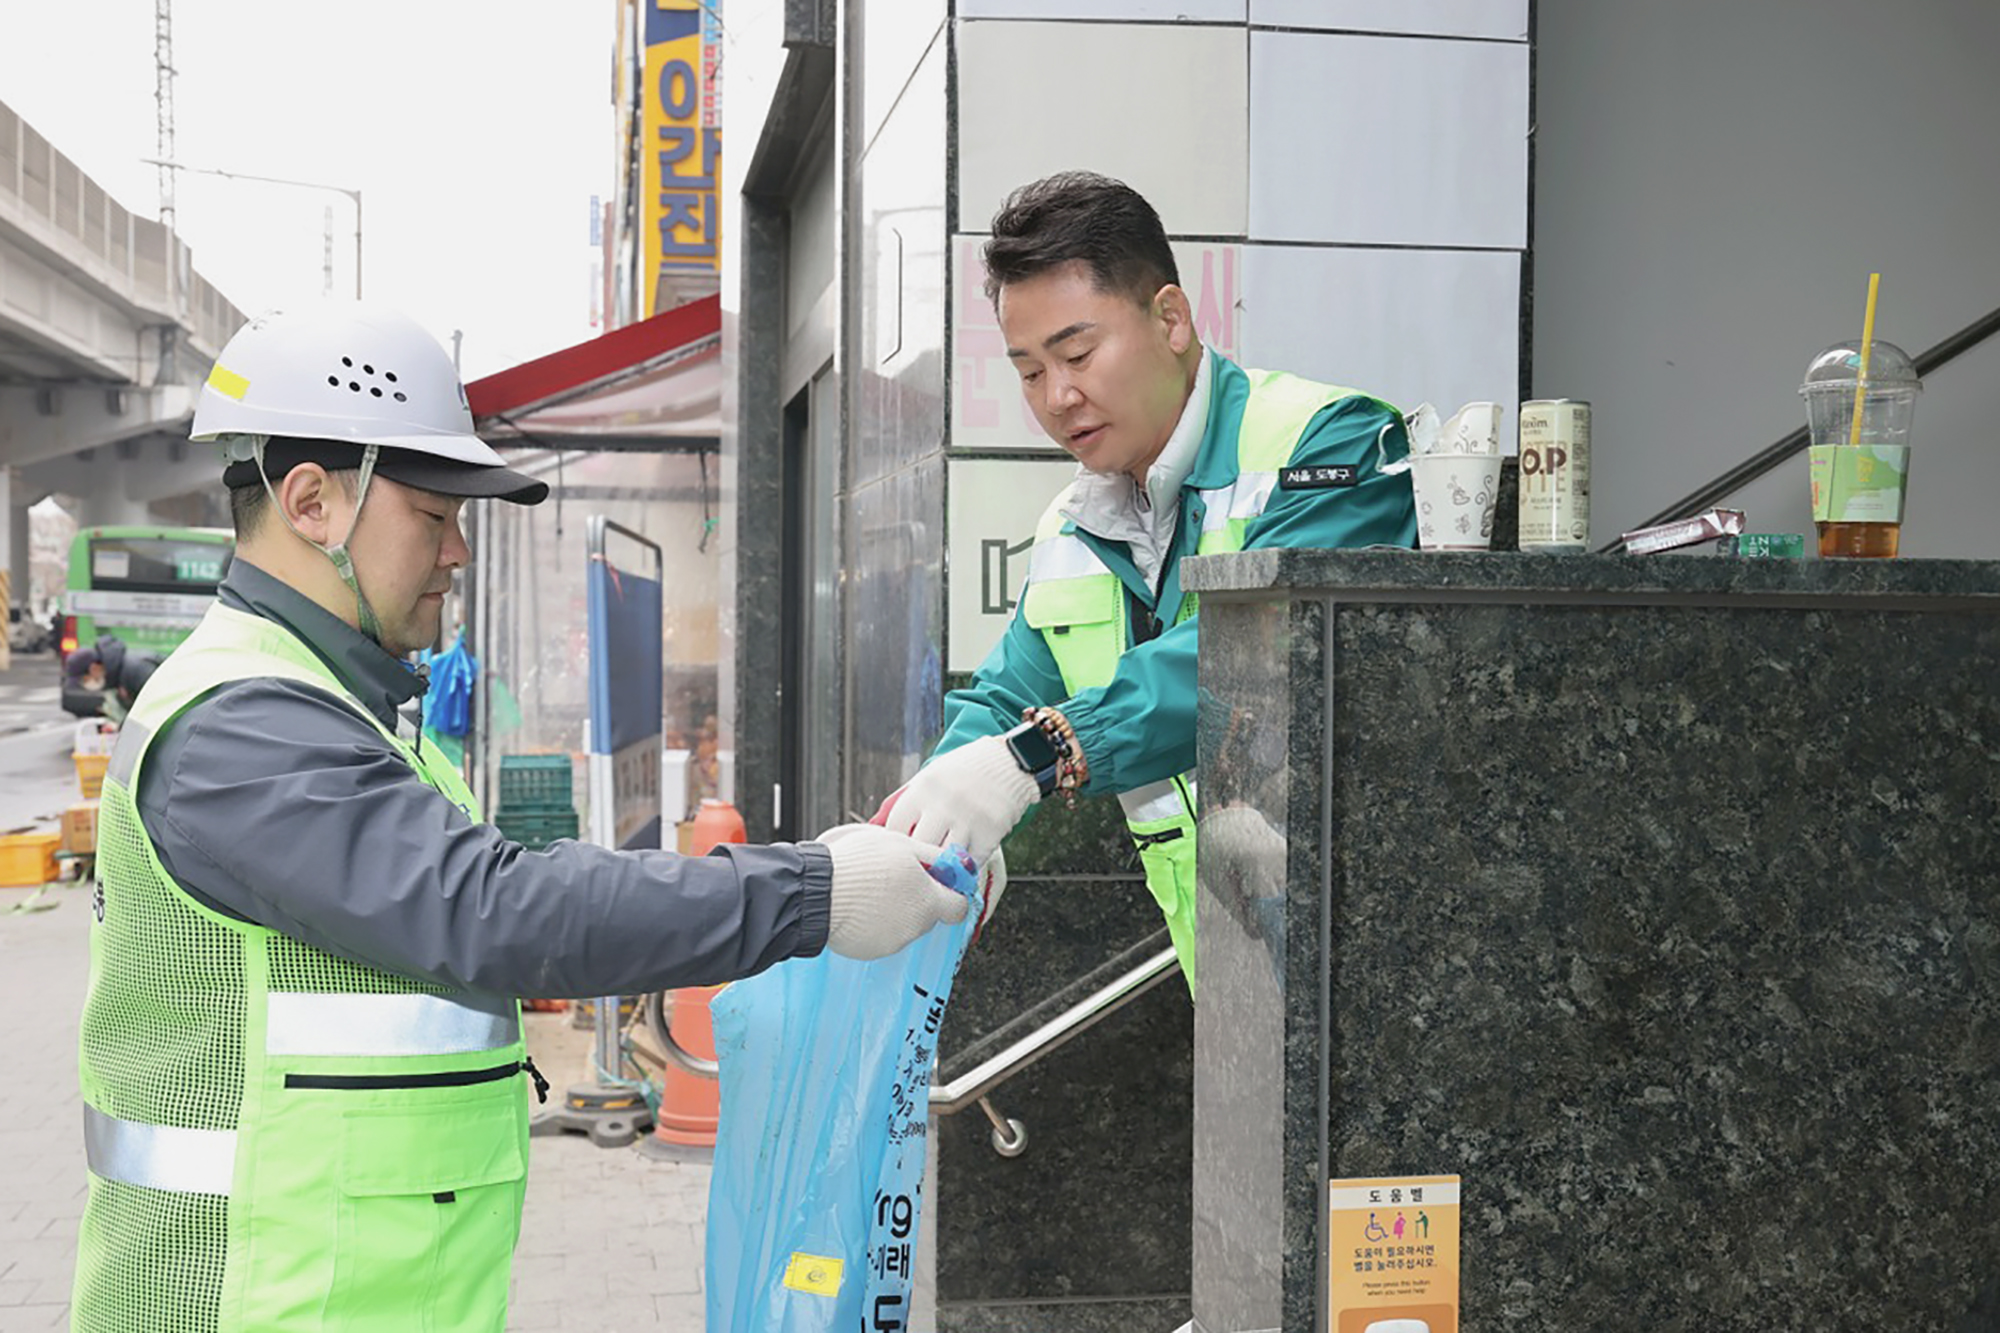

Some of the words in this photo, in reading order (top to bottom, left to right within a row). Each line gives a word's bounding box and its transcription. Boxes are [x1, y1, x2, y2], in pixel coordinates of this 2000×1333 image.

[1287, 469, 1311, 482] 서울
[1316, 468, 1350, 480] 도봉구
[1354, 1248, 1383, 1258] 도움이
[1387, 1245, 1434, 1257] 필요하시면
[1354, 1261, 1372, 1272] 벨을
